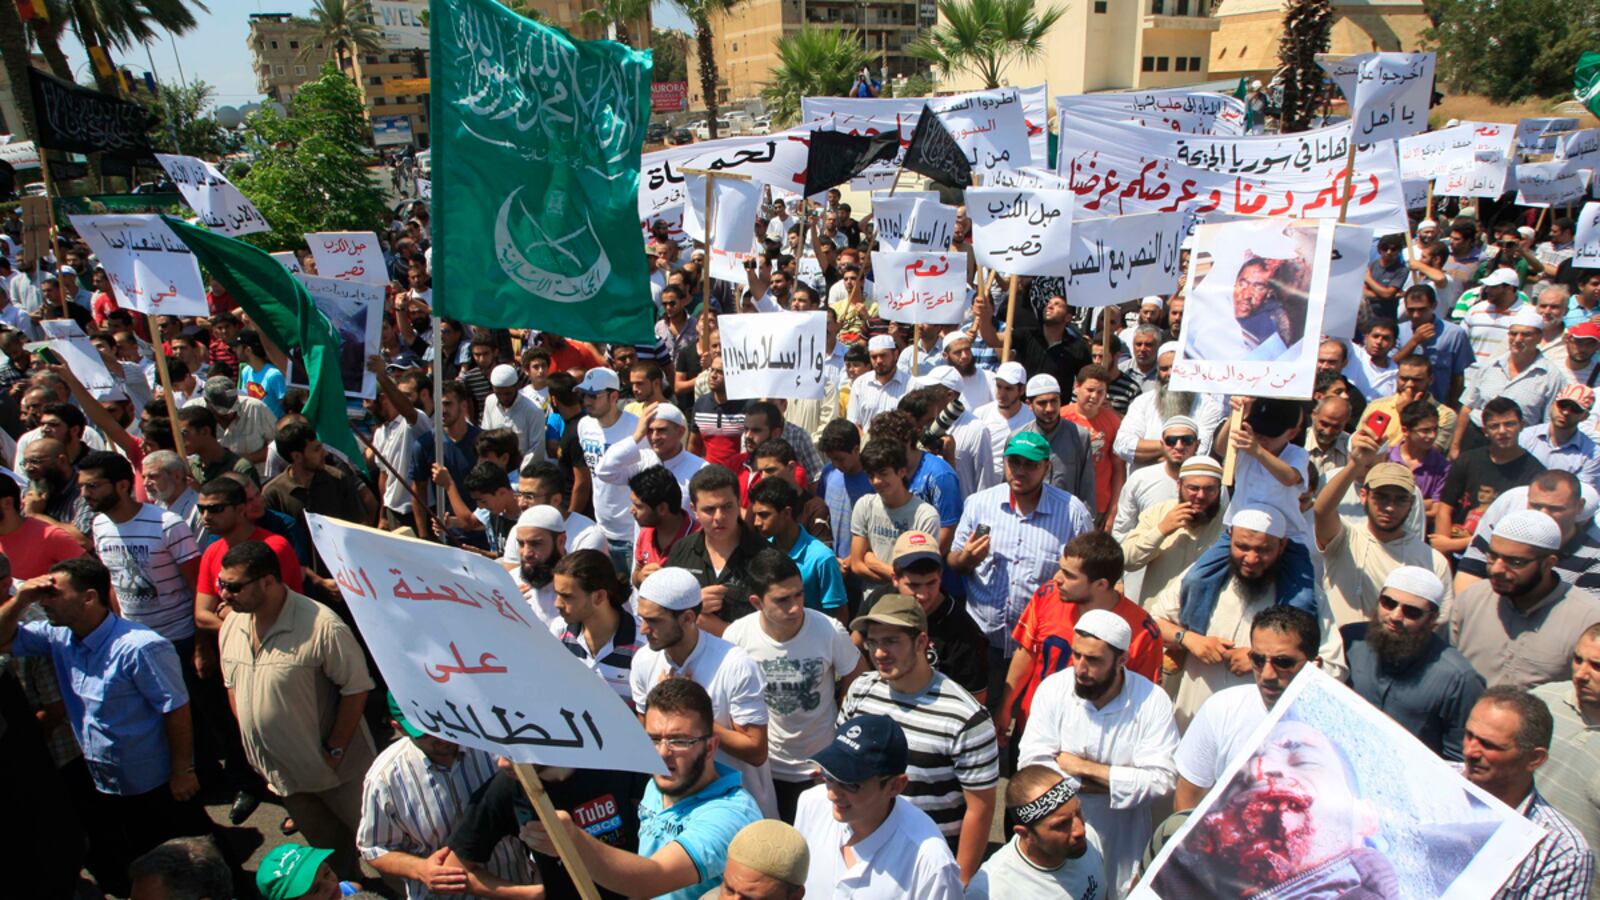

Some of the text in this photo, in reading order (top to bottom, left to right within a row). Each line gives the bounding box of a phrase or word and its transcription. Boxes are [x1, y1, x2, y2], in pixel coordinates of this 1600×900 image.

[1362, 102, 1415, 134] يا أهل
[985, 149, 1010, 169] من
[1294, 137, 1314, 172] في
[1195, 189, 1222, 213] و
[989, 234, 1042, 261] قصير
[1067, 238, 1105, 286] الصبر
[1127, 231, 1163, 281] النصر
[905, 255, 950, 288] نعم
[1108, 247, 1125, 289] مع
[1270, 373, 1297, 388] من
[335, 554, 378, 601] الله
[389, 568, 483, 609] لعنة
[424, 641, 508, 683] على
[410, 700, 604, 751] الظالمين
[575, 800, 616, 825] Tube
